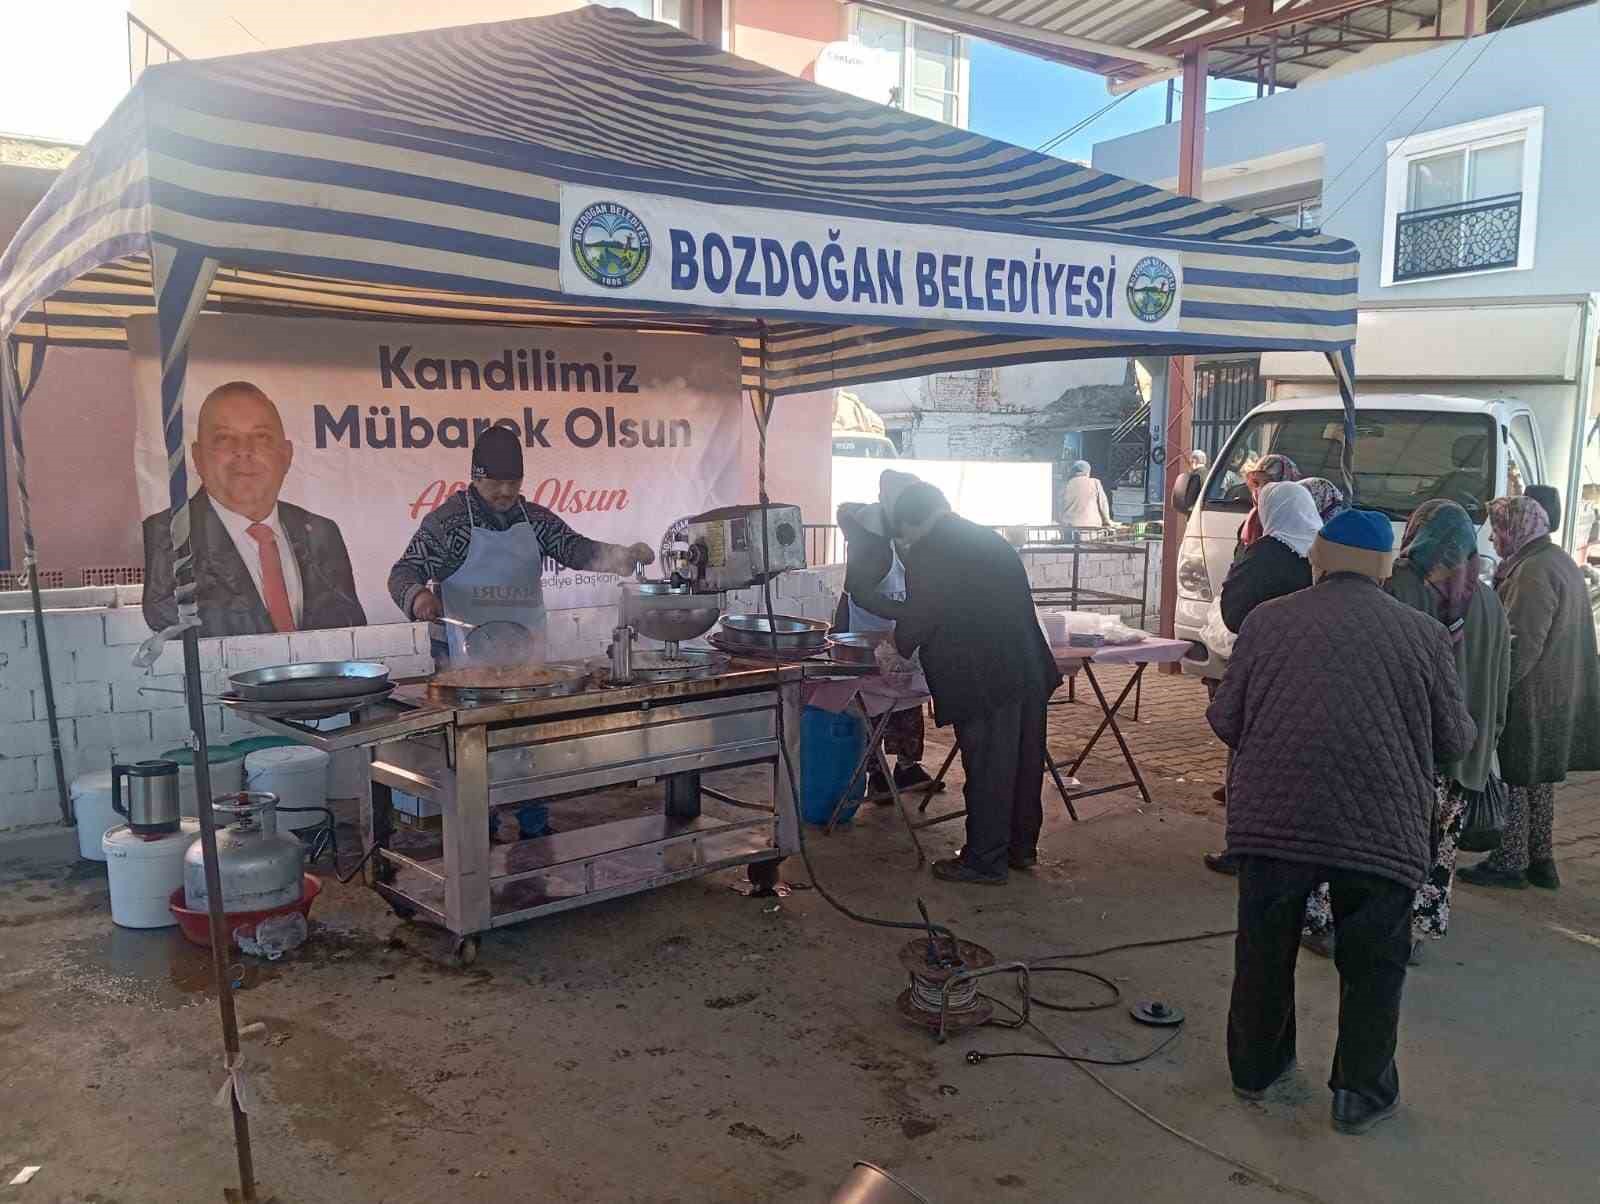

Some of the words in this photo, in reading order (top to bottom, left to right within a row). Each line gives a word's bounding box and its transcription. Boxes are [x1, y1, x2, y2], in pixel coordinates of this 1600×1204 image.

[669, 228, 904, 305] BOZDOĞAN
[915, 247, 1117, 319] BELEDİYESİ
[378, 345, 640, 394] Kandilimiz
[564, 406, 692, 449] Olsun
[533, 477, 631, 515] Olsun
